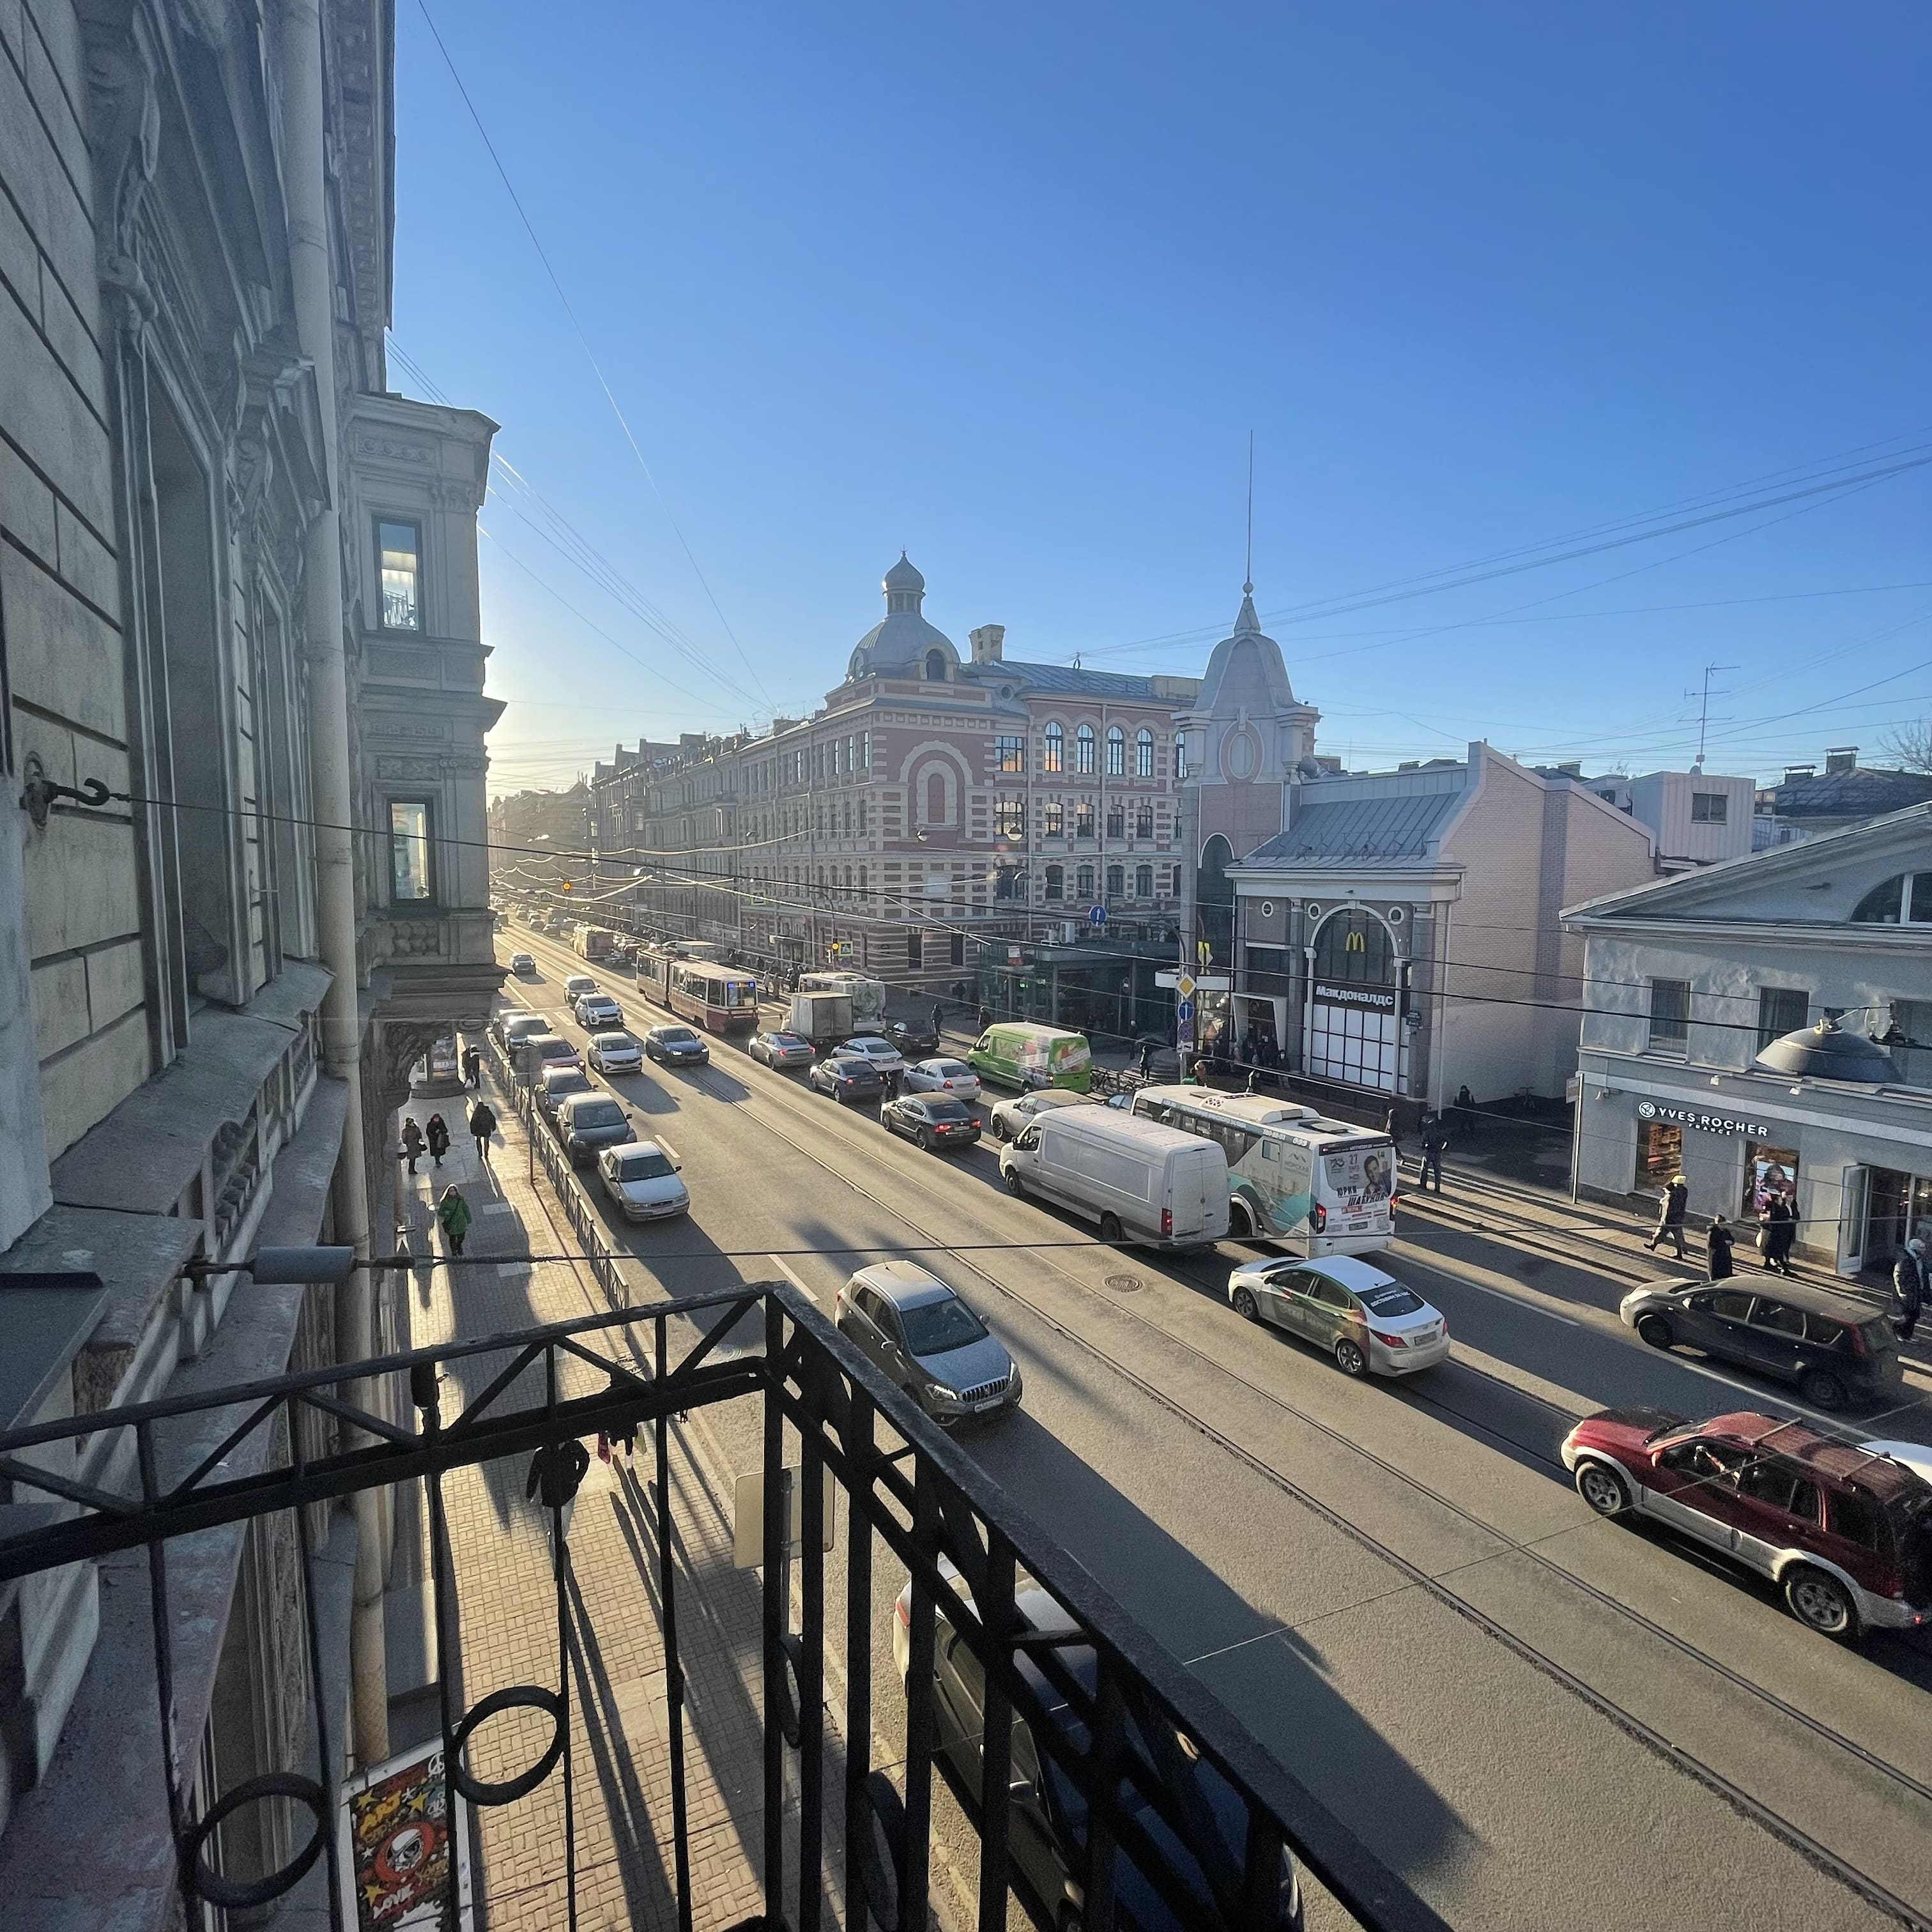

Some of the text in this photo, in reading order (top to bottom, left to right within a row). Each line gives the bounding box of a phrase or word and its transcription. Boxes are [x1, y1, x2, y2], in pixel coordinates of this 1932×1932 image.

[1316, 985, 1394, 1006] Макдоналдс
[1659, 1107, 1768, 1137] YVES ROCHER
[1688, 1123, 1731, 1136] FRANCE
